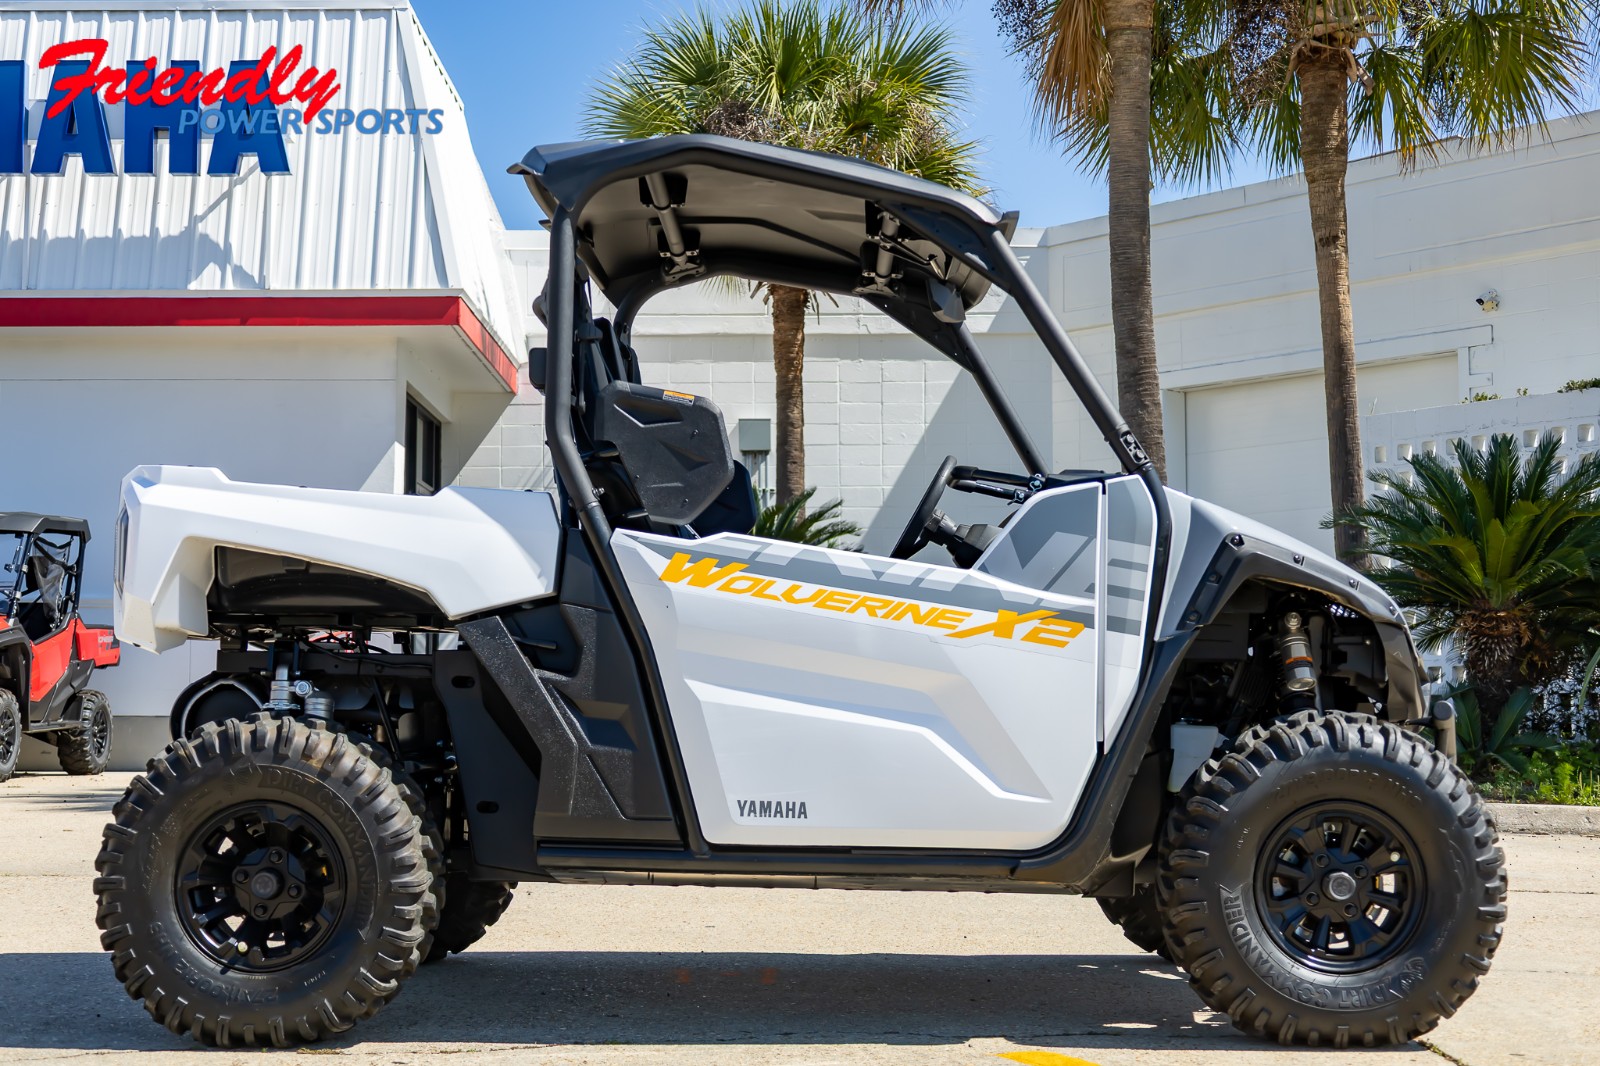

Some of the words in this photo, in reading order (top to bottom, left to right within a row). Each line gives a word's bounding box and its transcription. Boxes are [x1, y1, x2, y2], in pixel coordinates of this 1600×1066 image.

[944, 609, 1086, 649] X2
[737, 799, 808, 819] YAMAHA
[1223, 895, 1332, 1008] COMMANDER
[1339, 983, 1390, 1009] DIRT
